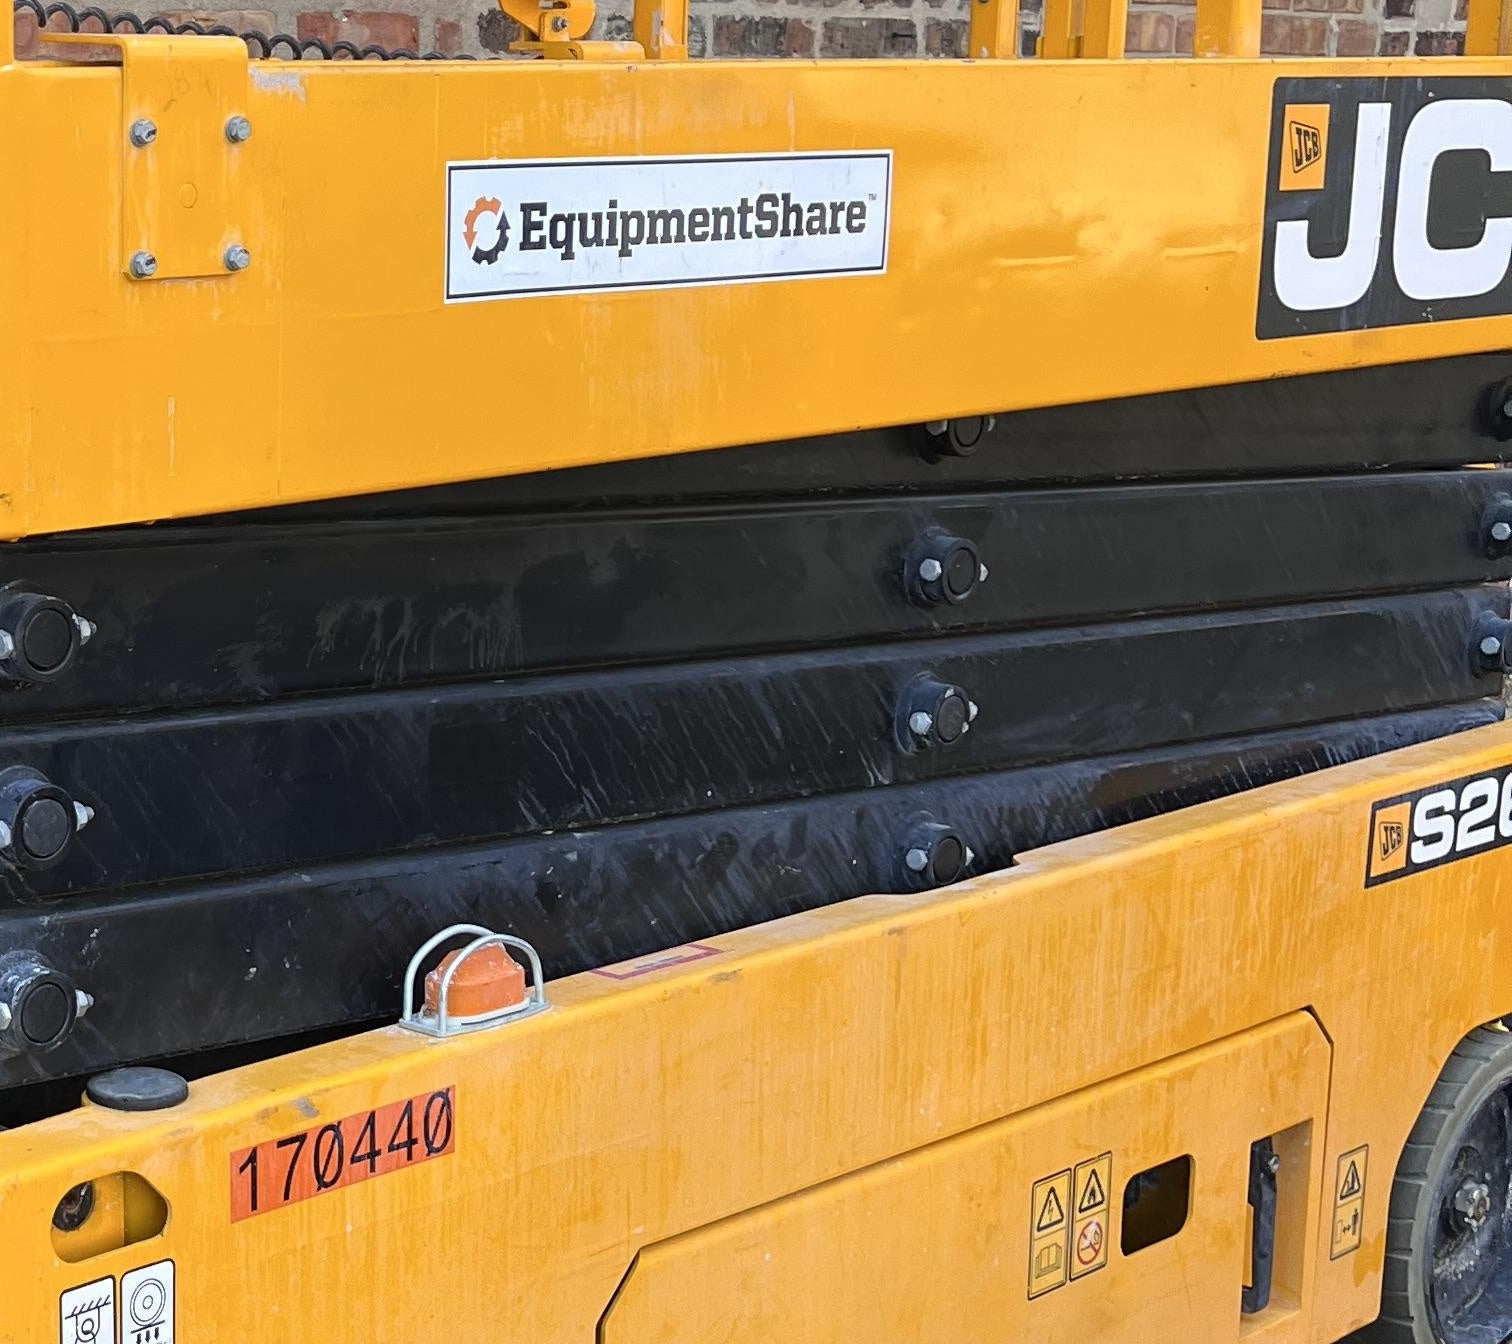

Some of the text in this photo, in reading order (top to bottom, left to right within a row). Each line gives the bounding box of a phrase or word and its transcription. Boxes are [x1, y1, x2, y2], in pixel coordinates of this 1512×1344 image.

[1294, 126, 1320, 168] JCB
[1382, 824, 1403, 856] JCB
[238, 1087, 454, 1213] 170440
